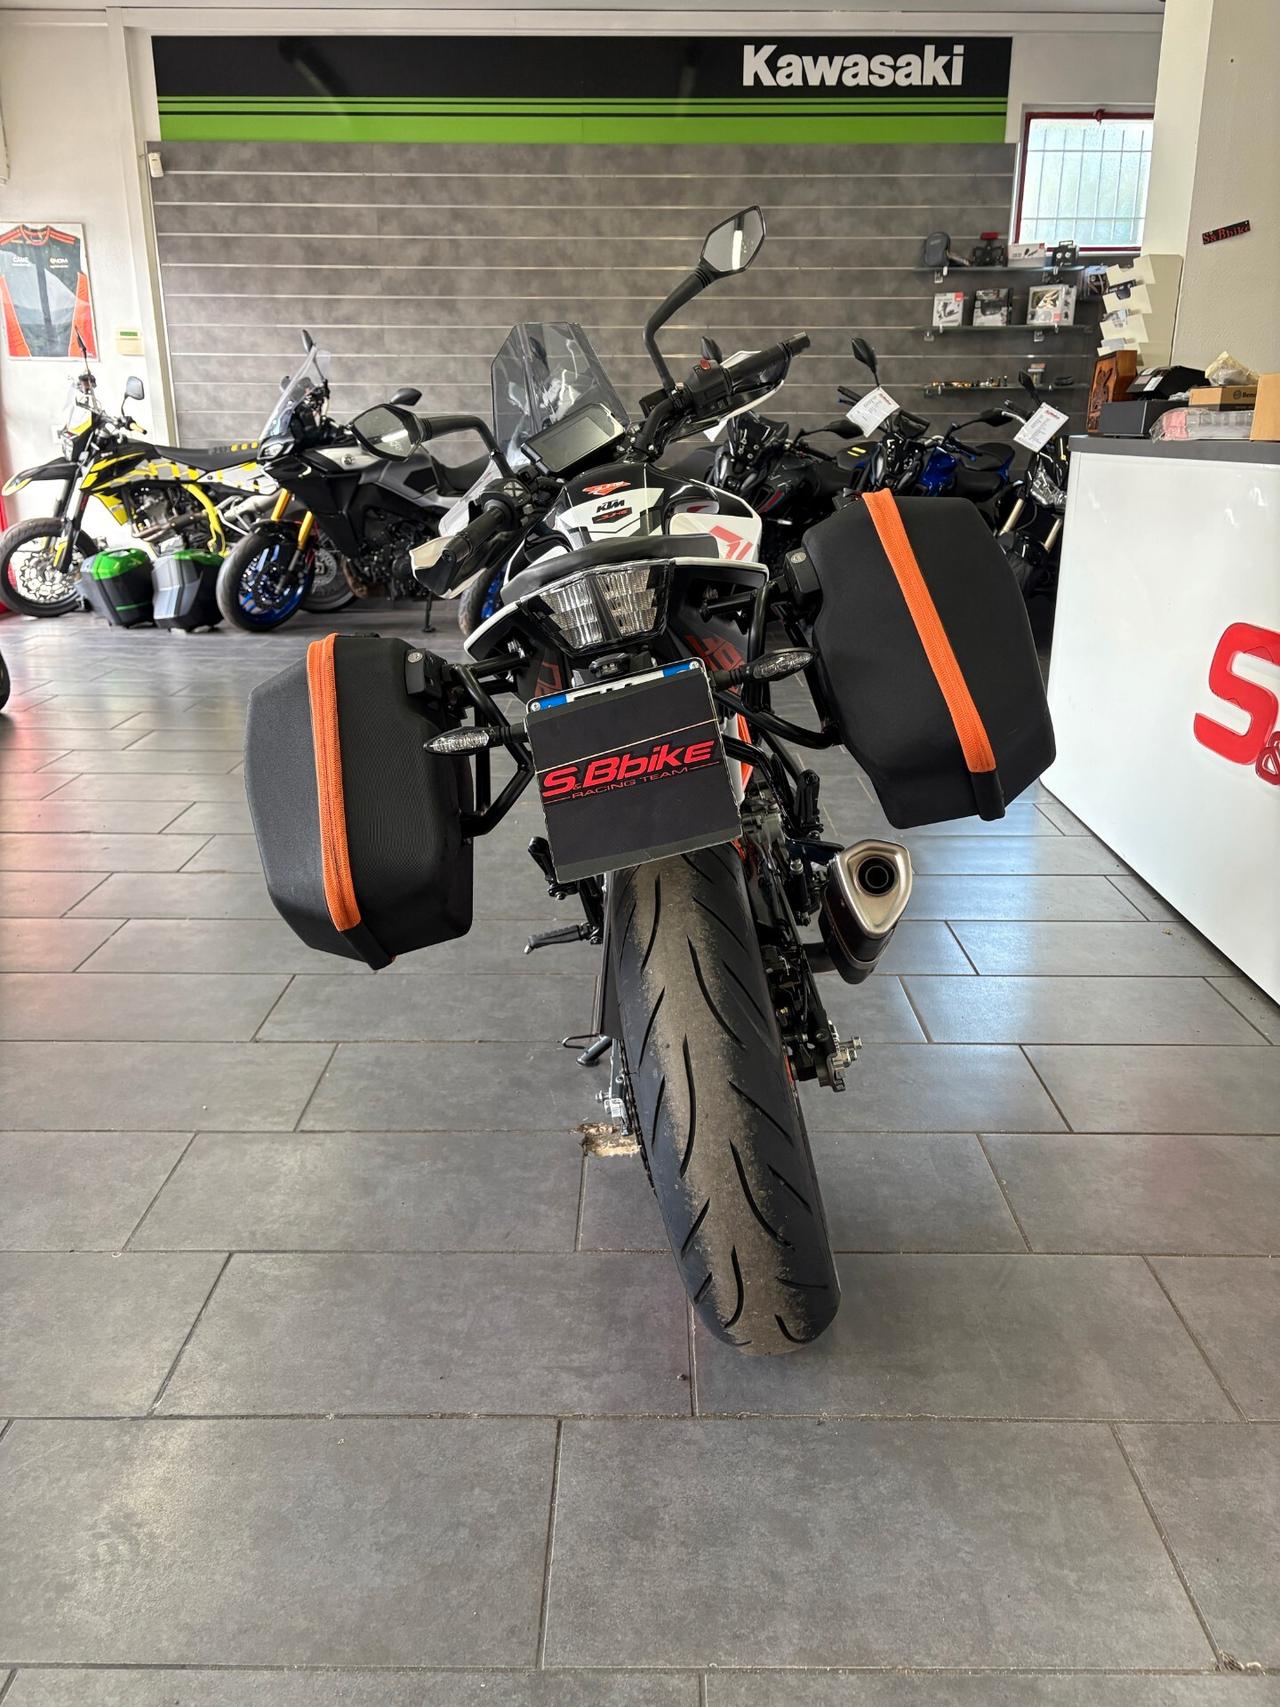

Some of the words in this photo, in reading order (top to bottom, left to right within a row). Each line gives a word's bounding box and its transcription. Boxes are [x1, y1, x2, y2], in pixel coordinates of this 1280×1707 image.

[743, 44, 965, 87] Kawasaki
[596, 499, 625, 513] KTM
[572, 780, 637, 799] RACING
[640, 766, 688, 783] TEAM
